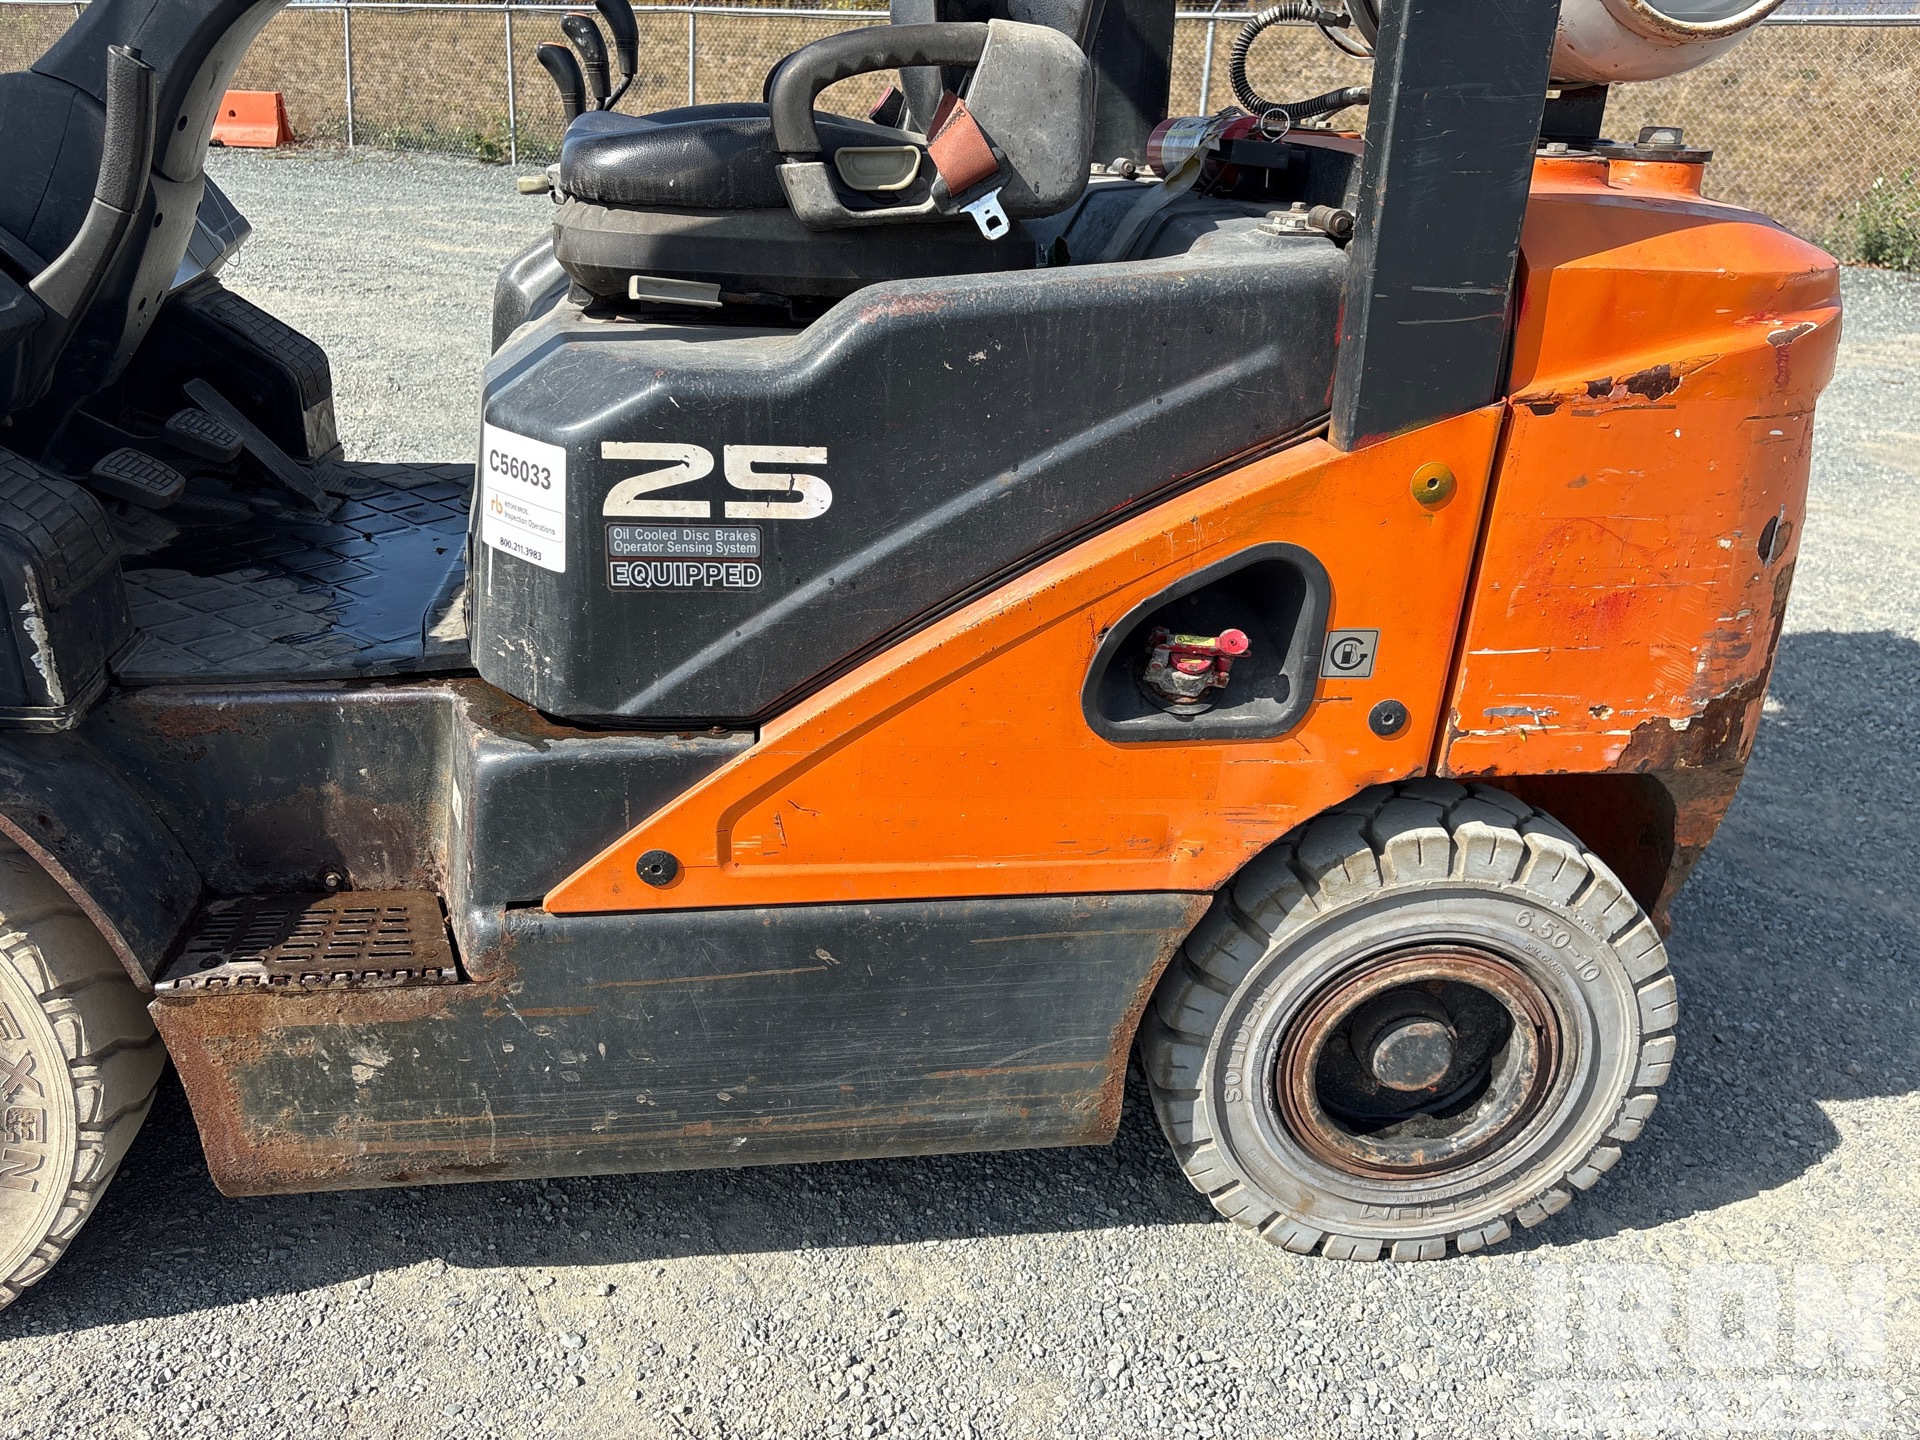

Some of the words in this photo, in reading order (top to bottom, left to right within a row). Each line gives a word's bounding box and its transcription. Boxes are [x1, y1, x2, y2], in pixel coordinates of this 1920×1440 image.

[490, 449, 552, 491] C56033
[600, 442, 833, 520] 25
[504, 510, 527, 525] Inspection
[528, 518, 556, 536] Operations
[613, 528, 630, 540] Oil
[635, 528, 677, 541] Cooled
[683, 529, 710, 541] Disc
[715, 529, 757, 541] Brakes
[500, 536, 542, 561] 800.211.3983
[613, 540, 664, 555] Operator
[667, 541, 713, 556] Sensing
[715, 541, 757, 556] System
[610, 561, 762, 588] EQUIPPED
[1515, 908, 1601, 982] 6.50-10
[1224, 981, 1282, 1104] SOLIDEAL
